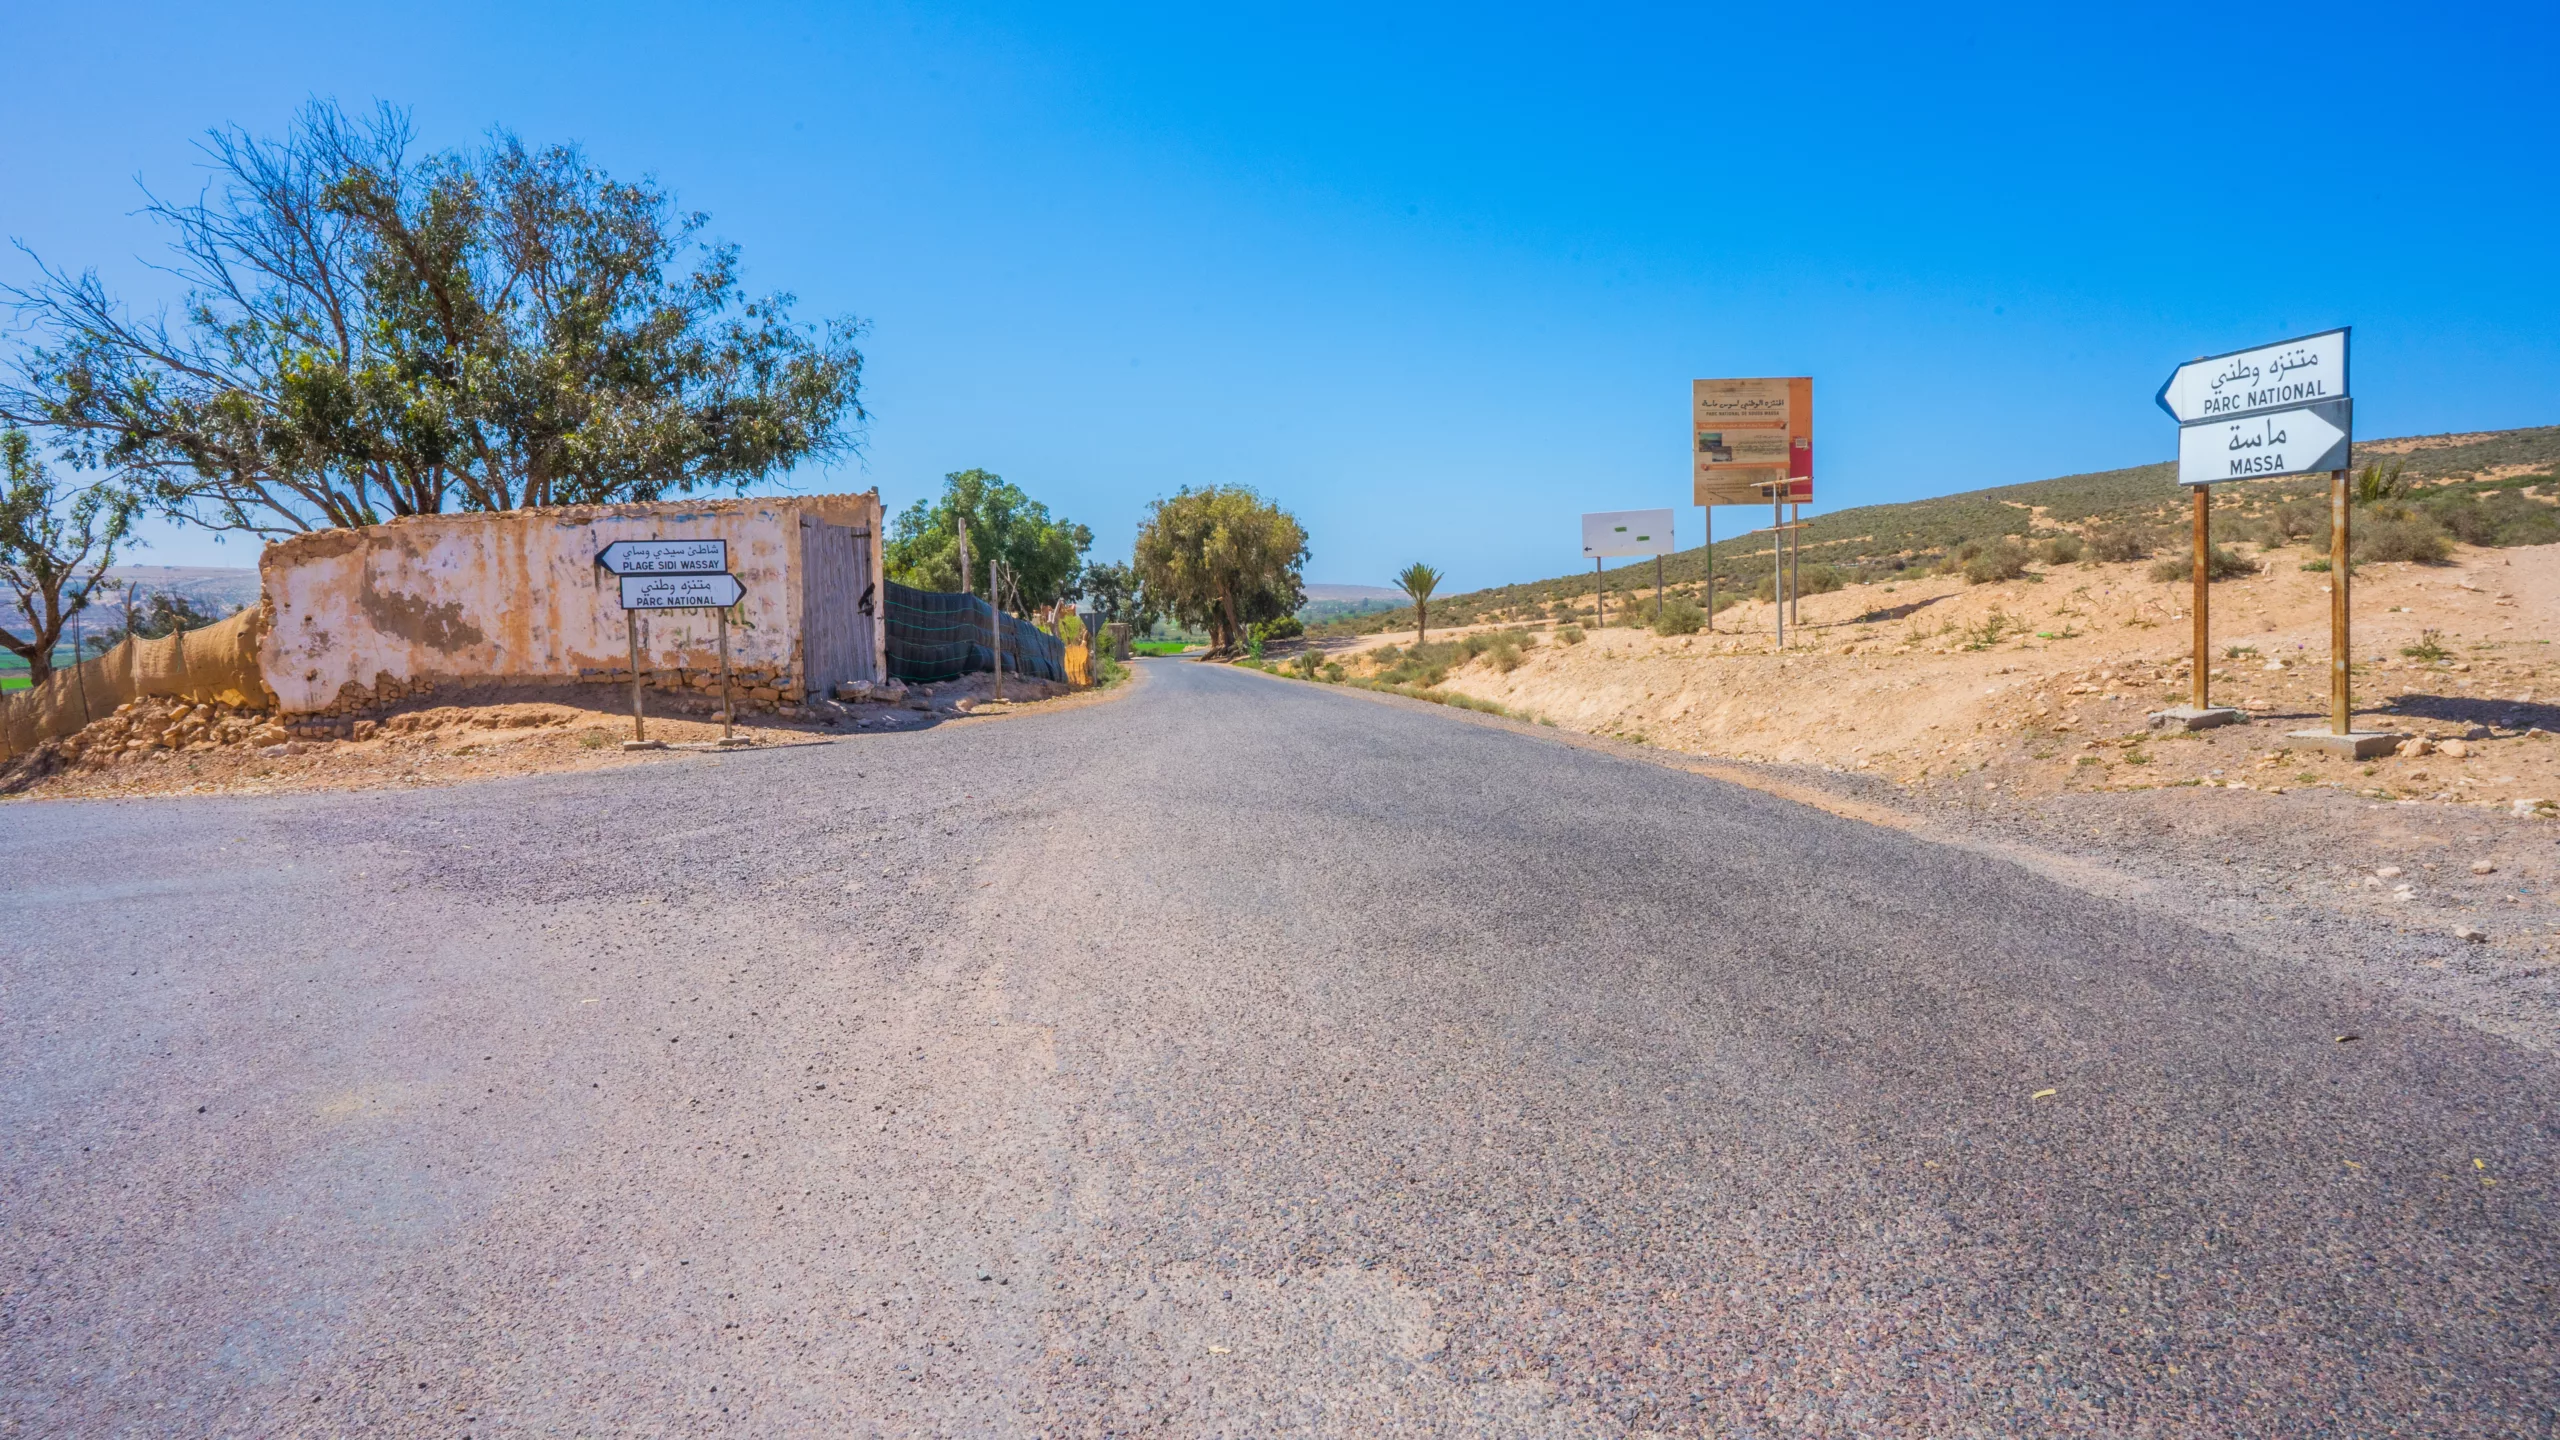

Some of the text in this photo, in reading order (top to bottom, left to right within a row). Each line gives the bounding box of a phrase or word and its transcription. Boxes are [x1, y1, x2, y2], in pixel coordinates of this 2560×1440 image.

[2211, 349, 2318, 395] متنزه وطني
[2204, 380, 2326, 414] PARC NATIONAL
[2228, 418, 2286, 451] ماسة
[2230, 454, 2284, 476] MASSA
[623, 545, 719, 560] شاطئ سيدي وساي
[623, 560, 720, 571] PLAGE SIDI WASSAY
[641, 579, 711, 596] متنزه وطني
[636, 596, 716, 606] PARC NATIONAL
